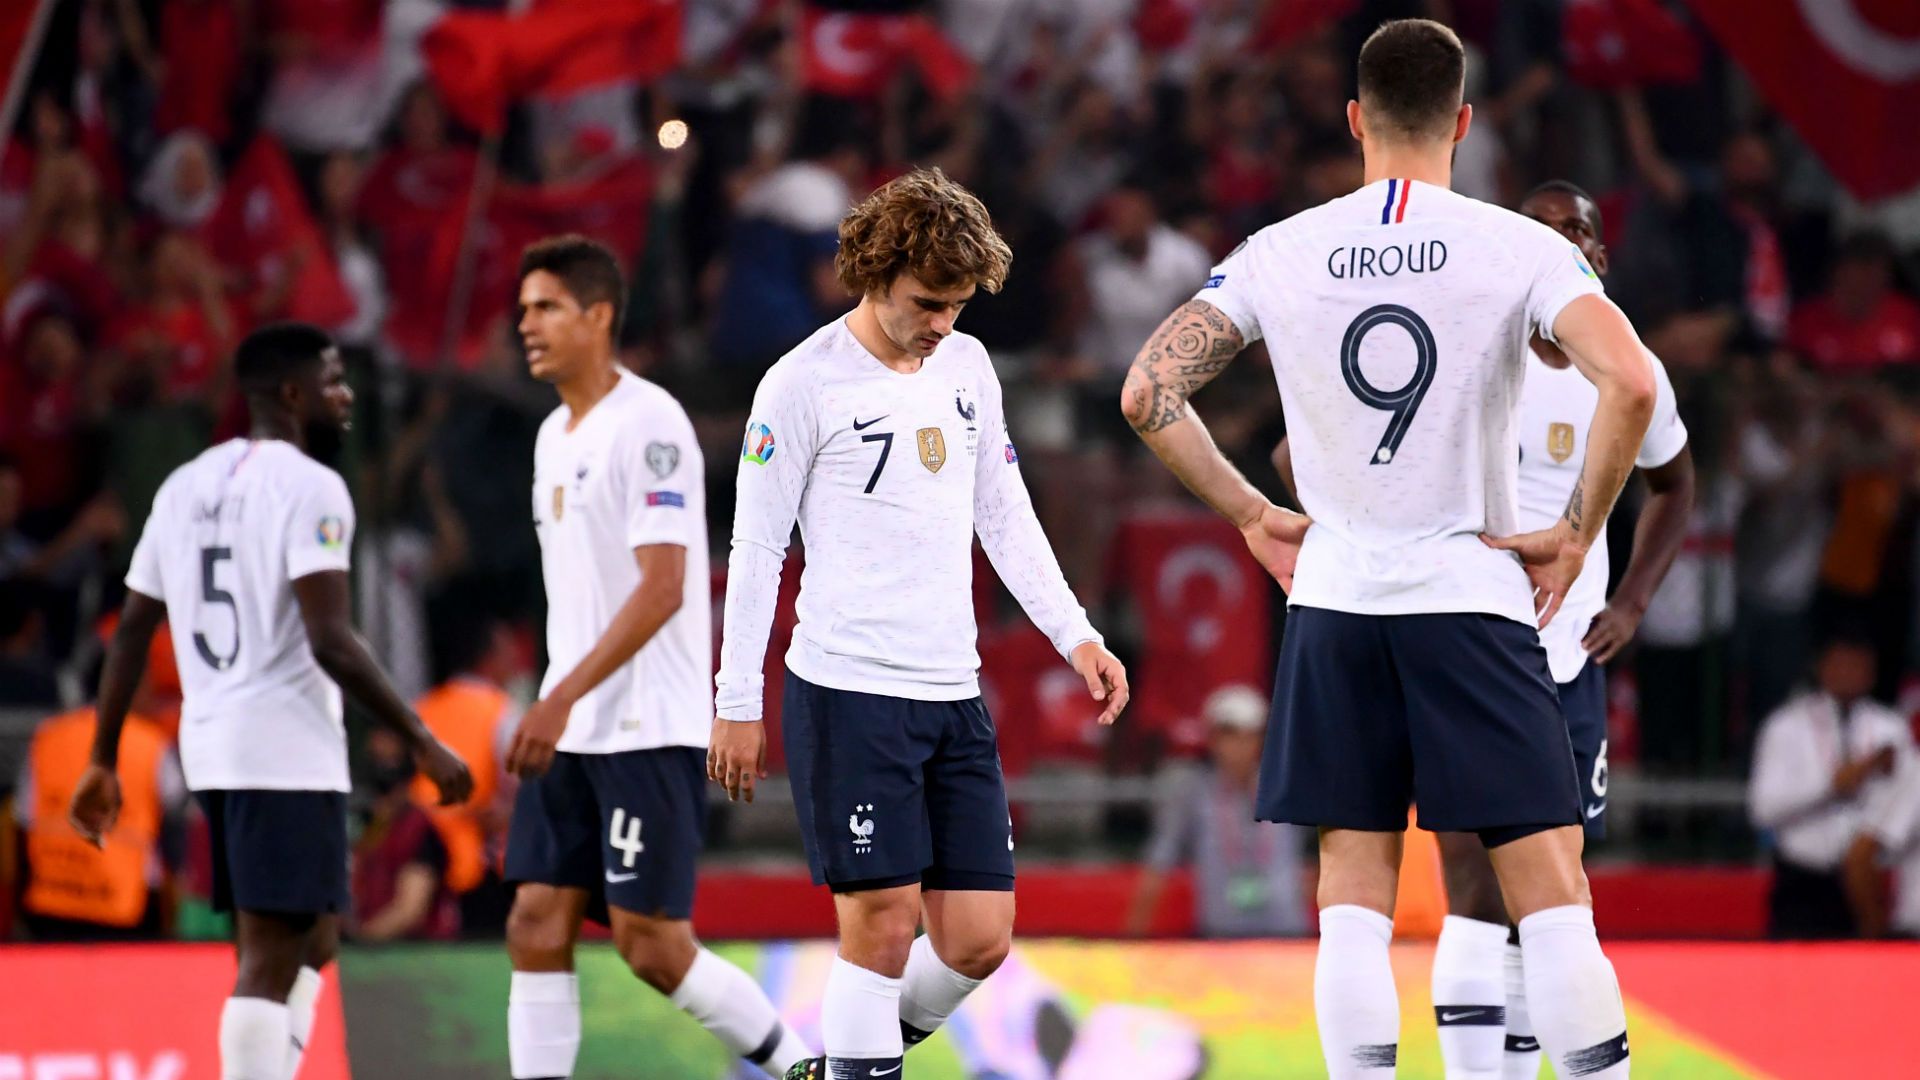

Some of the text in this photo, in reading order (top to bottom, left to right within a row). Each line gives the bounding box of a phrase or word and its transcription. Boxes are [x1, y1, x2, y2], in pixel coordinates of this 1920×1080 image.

[1328, 240, 1447, 279] GIROUD
[1340, 303, 1438, 466] 9
[861, 432, 894, 494] 7
[193, 547, 241, 671] 5
[609, 807, 644, 868] 4
